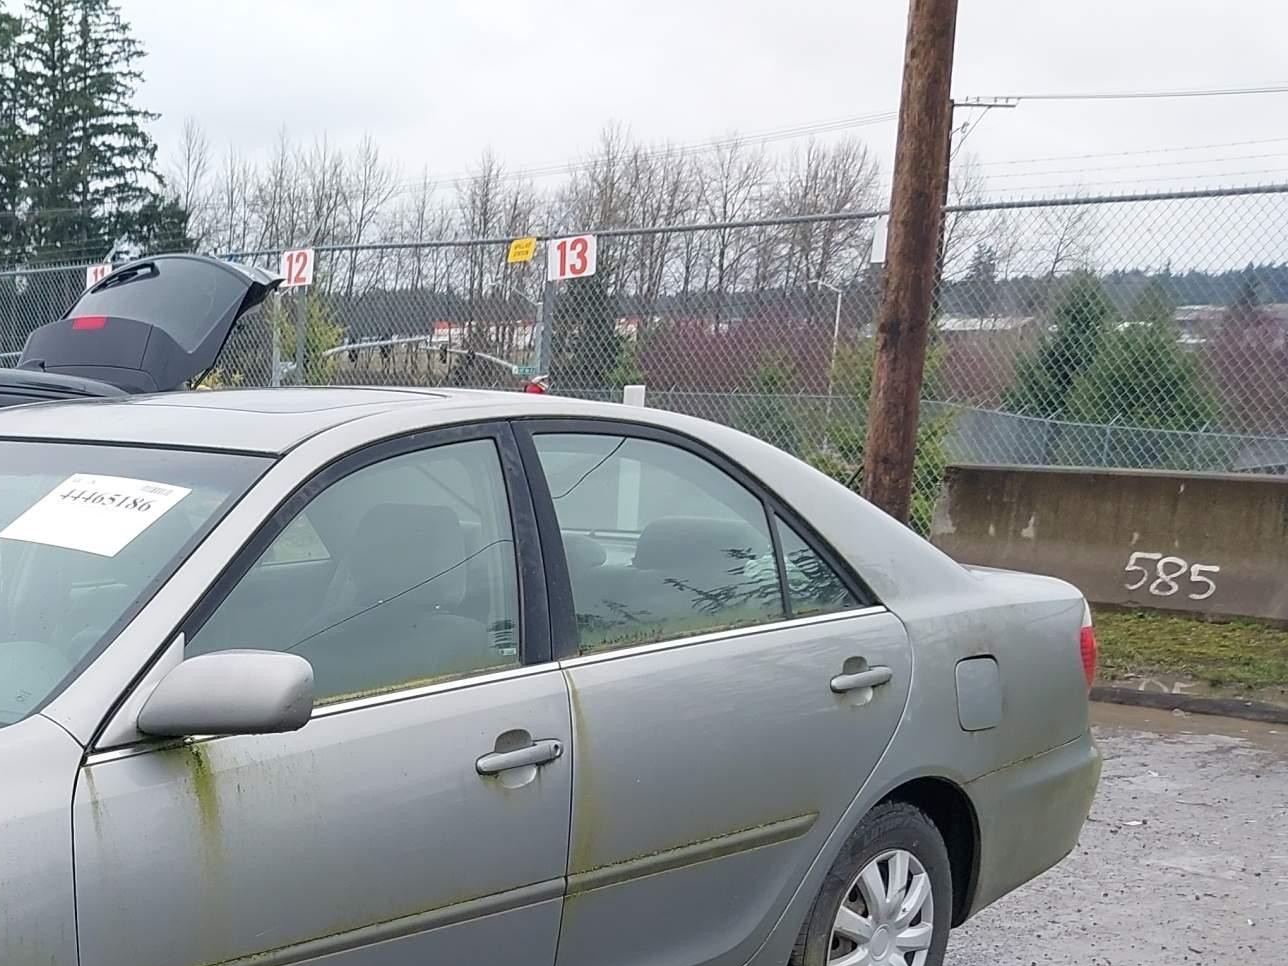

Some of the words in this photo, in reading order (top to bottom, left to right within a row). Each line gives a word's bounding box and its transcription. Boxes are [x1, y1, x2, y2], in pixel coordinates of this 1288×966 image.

[286, 251, 307, 284] 12
[557, 238, 588, 277] 13
[60, 488, 156, 512] 44465186
[1124, 551, 1220, 600] 585
